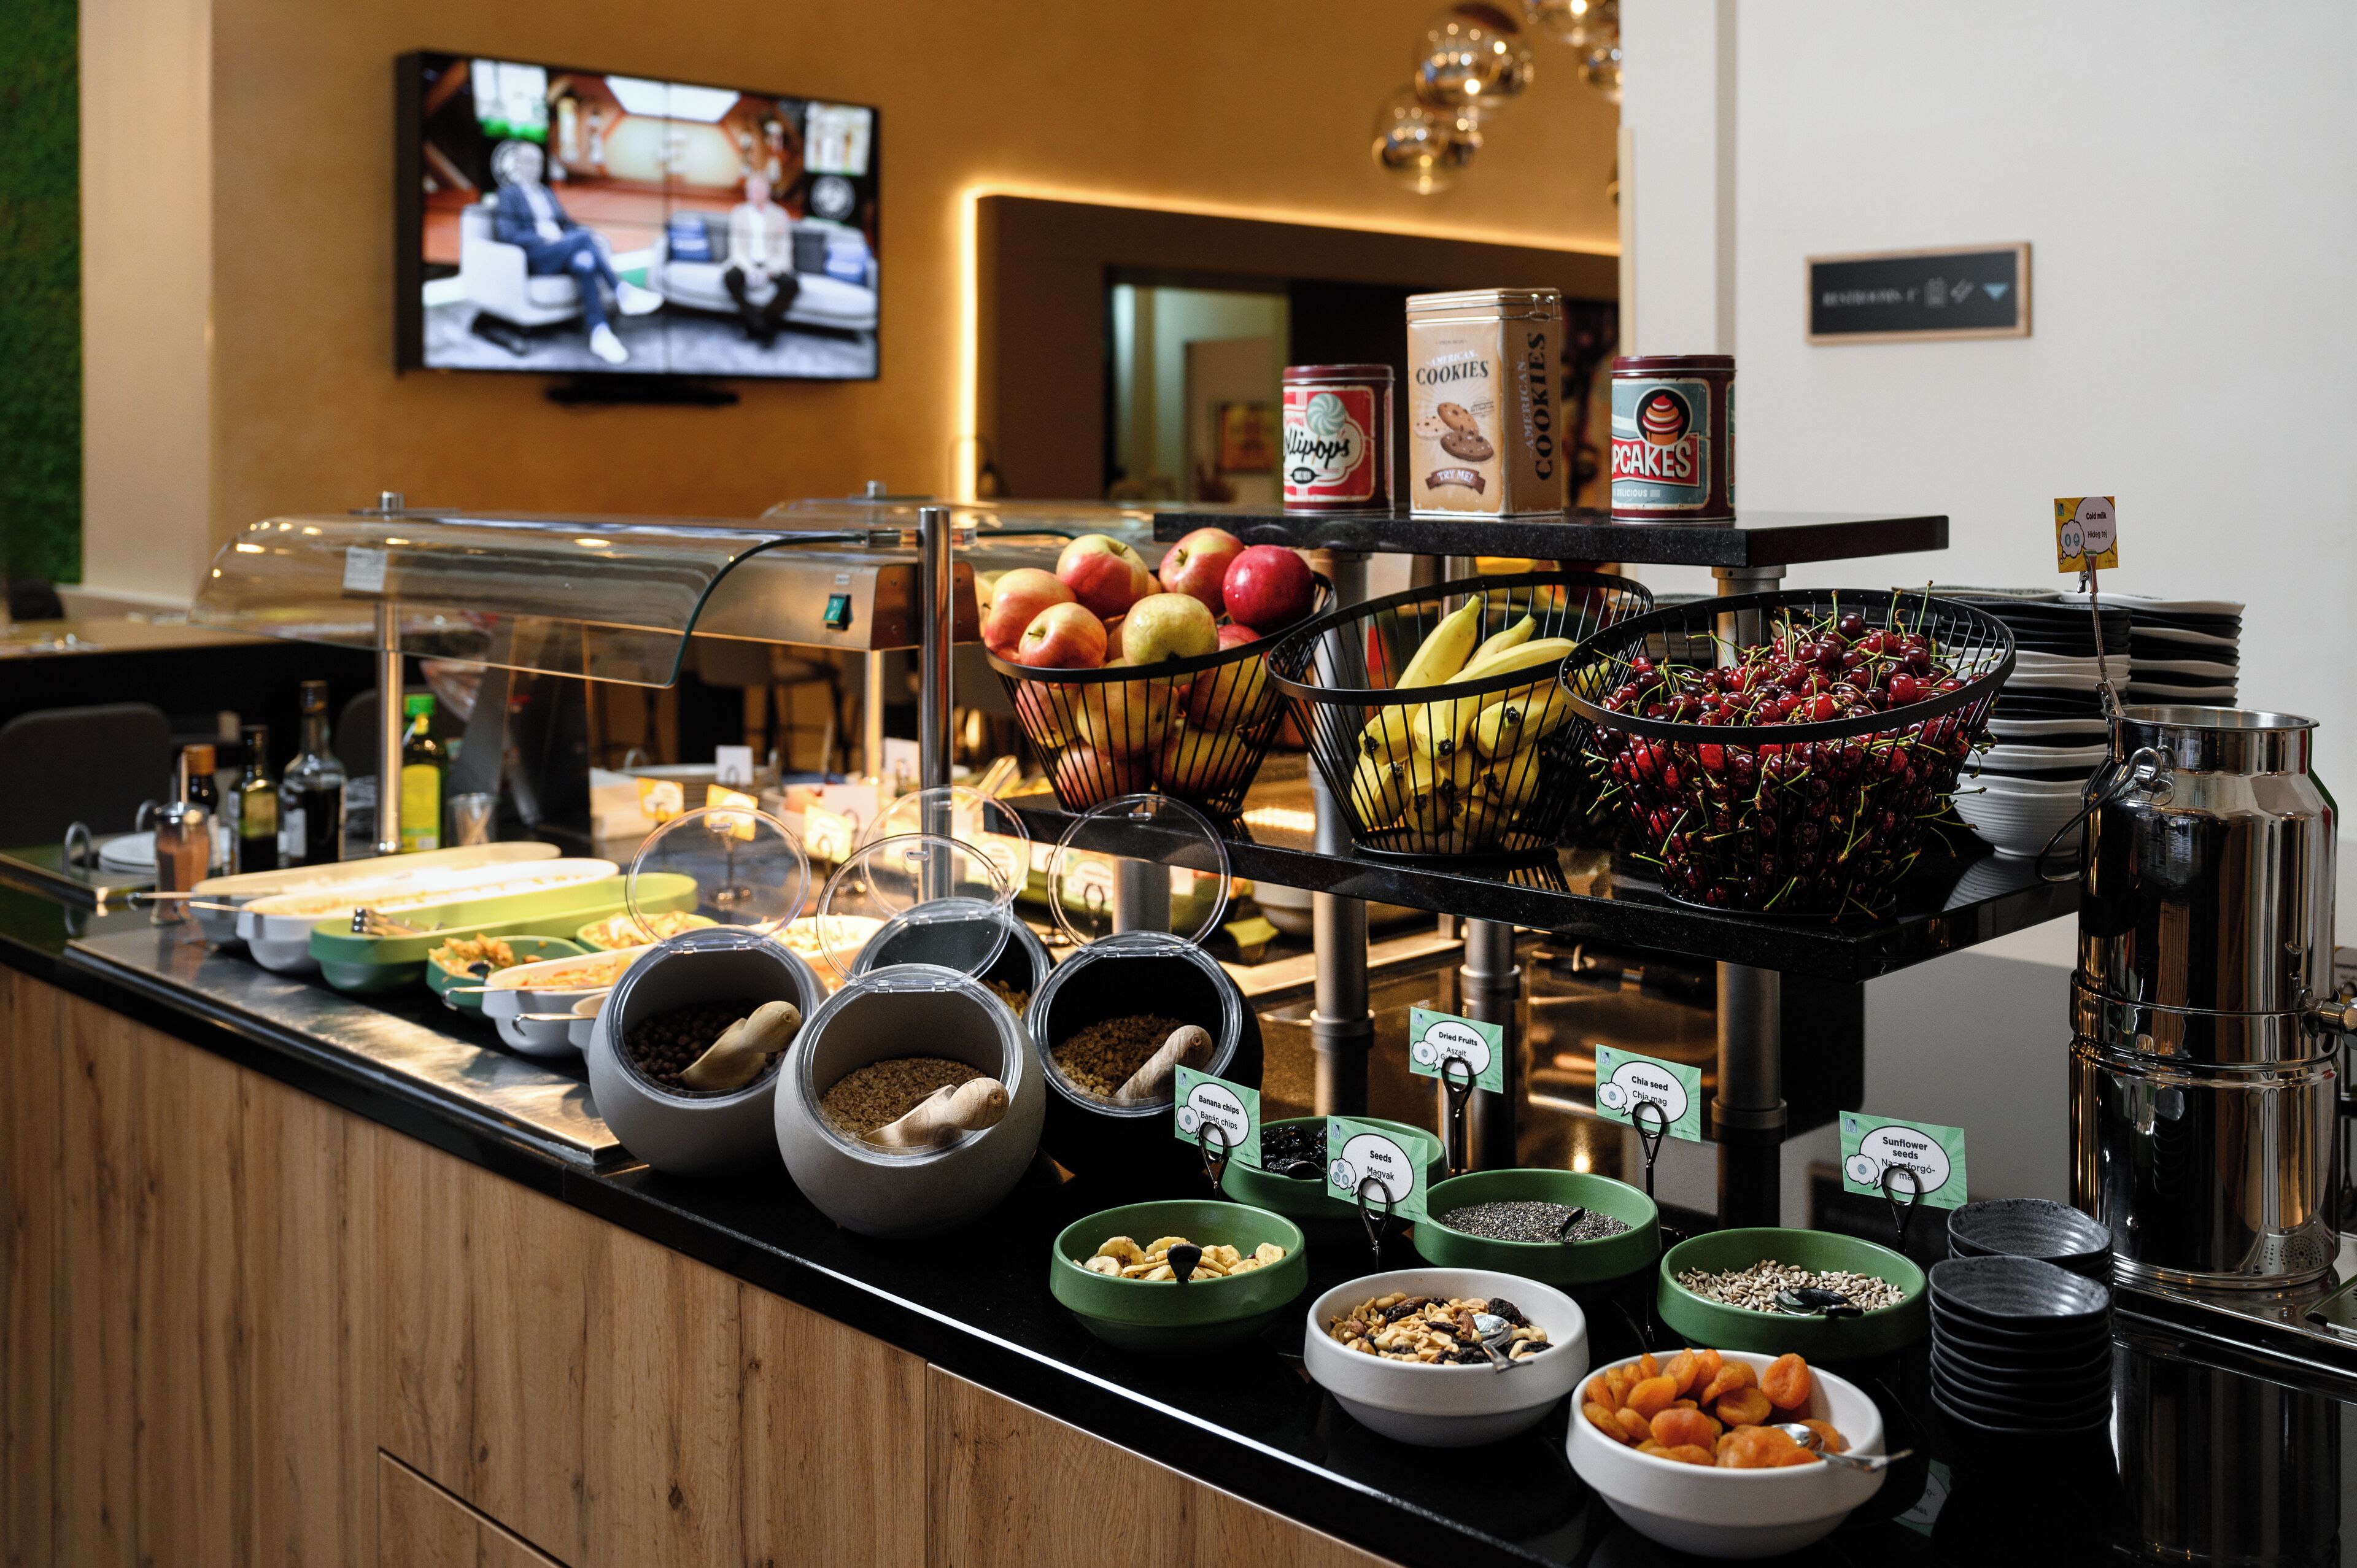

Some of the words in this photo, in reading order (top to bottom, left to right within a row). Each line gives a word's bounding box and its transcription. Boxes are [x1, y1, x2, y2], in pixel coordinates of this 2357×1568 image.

[1415, 360, 1489, 385] COOKIES
[1517, 360, 1534, 452] AMERICAN
[1527, 333, 1553, 481] COOKIES
[1436, 469, 1455, 481] TRY
[2097, 511, 2107, 520] milk
[1439, 1031, 1457, 1041] Dried
[1458, 1036, 1477, 1046] Fruits
[1446, 1046, 1466, 1057] Aszalt
[1631, 1076, 1649, 1086] Chia
[1650, 1080, 1668, 1091] seed
[1198, 1094, 1221, 1109] Banana
[1222, 1103, 1239, 1115] chips
[1632, 1091, 1649, 1100] Chia
[1651, 1096, 1668, 1106] mag
[1221, 1118, 1238, 1130] chips
[1883, 1137, 1928, 1151] Sunflower
[1369, 1150, 1392, 1163] Seeds
[1892, 1149, 1919, 1160] seeds
[1367, 1166, 1395, 1181] Magvak
[1881, 1158, 1935, 1174] Naforgó-
